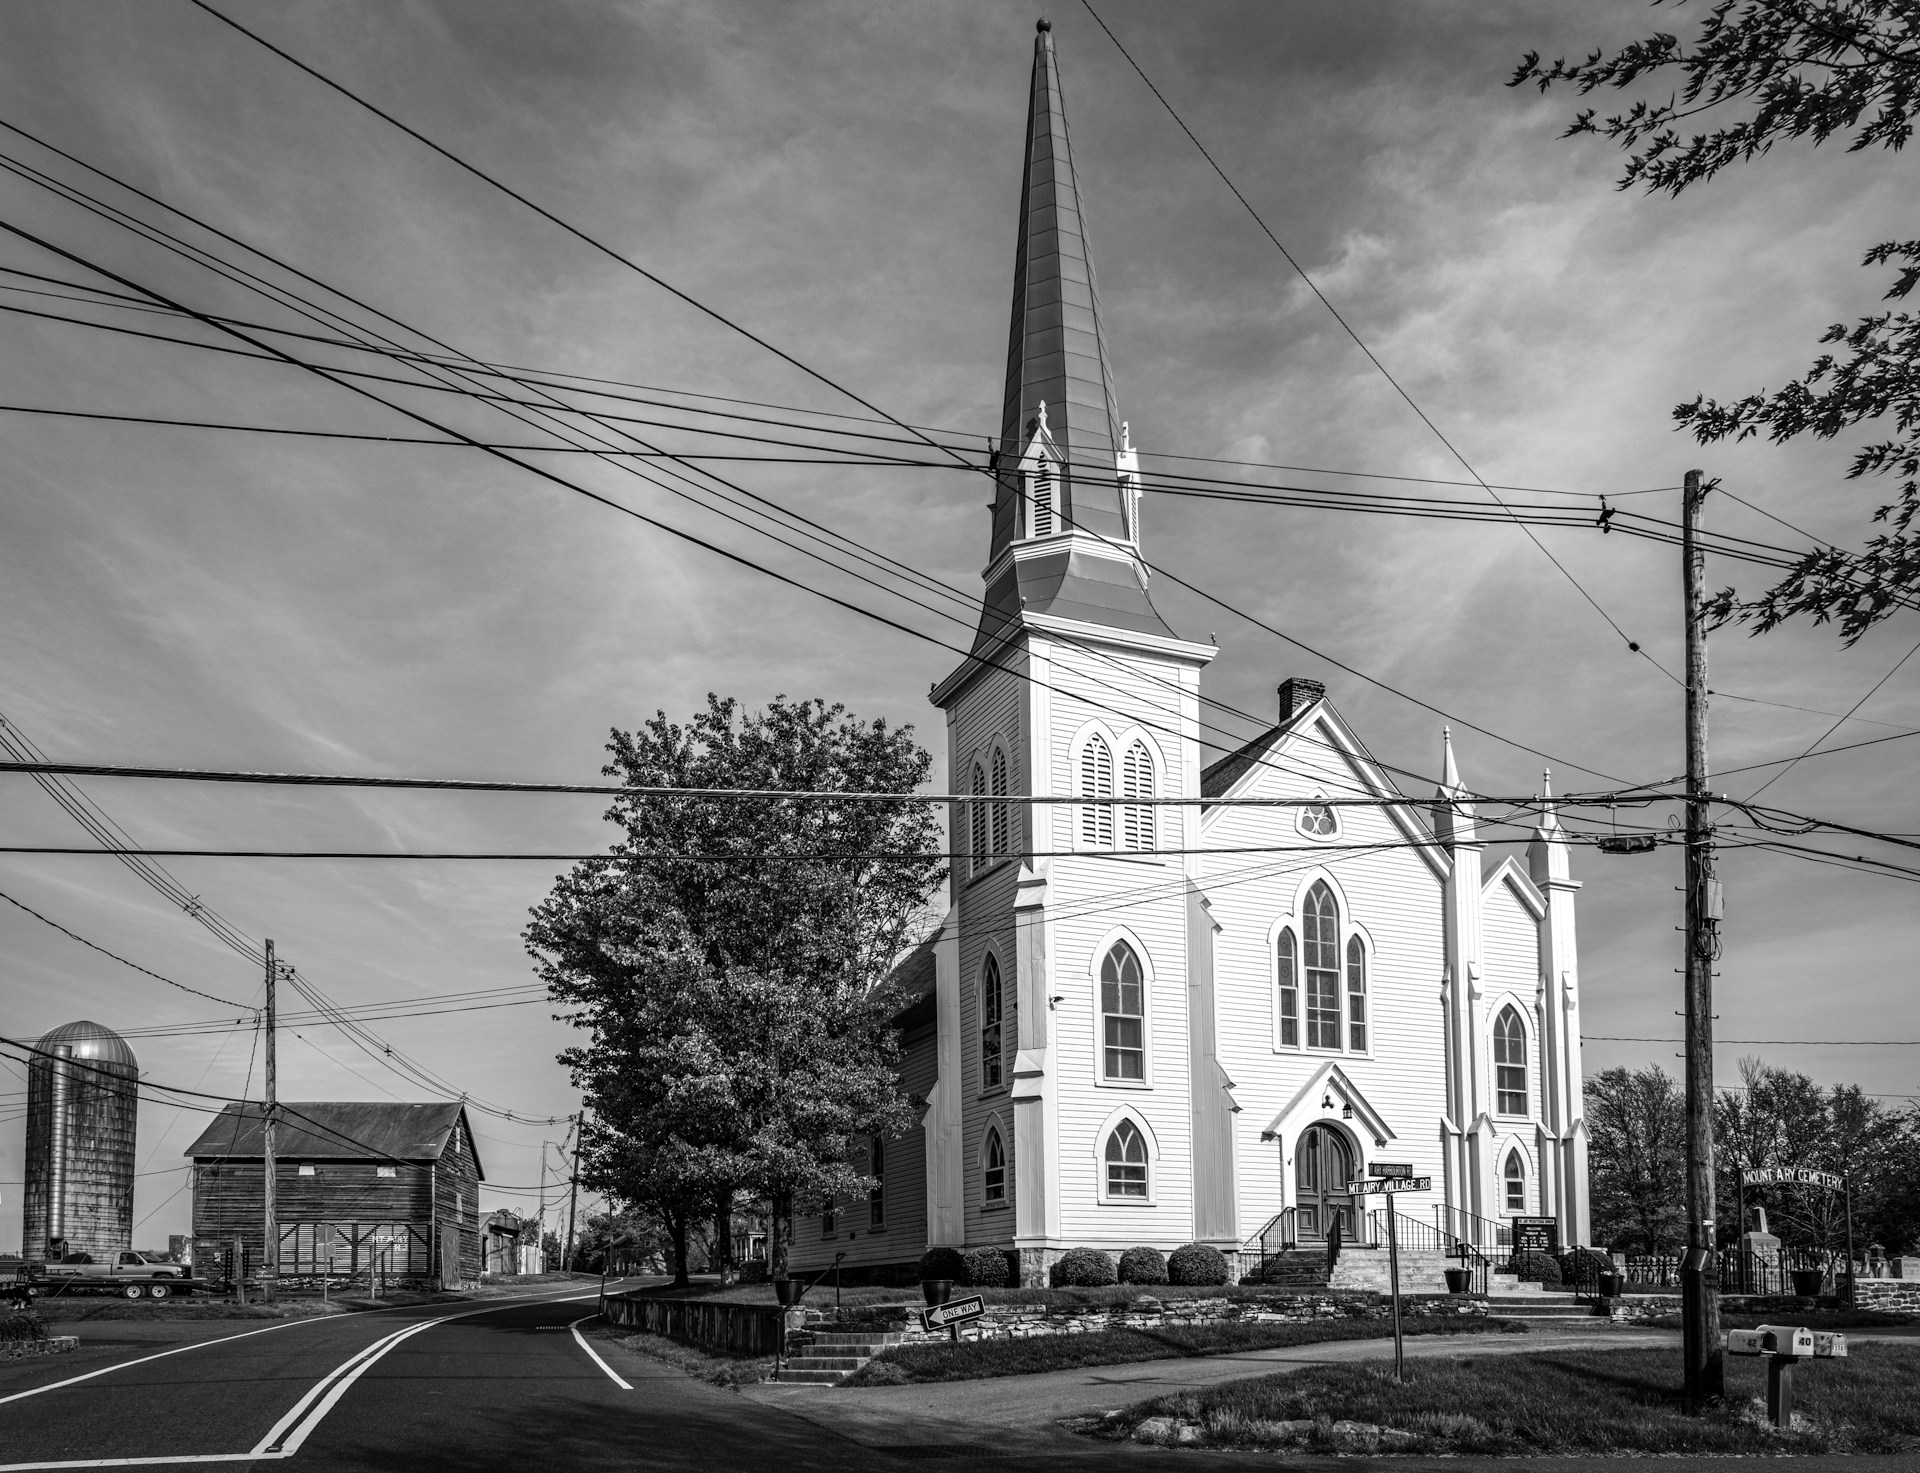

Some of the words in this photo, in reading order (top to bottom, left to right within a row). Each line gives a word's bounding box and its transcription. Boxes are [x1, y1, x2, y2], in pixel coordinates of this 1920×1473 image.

[1348, 1182, 1360, 1194] MT
[1362, 1181, 1380, 1193] AIRY
[1384, 1179, 1416, 1192] VILLAGE
[1419, 1178, 1431, 1190] RD
[1743, 1168, 1772, 1184] MOUNT
[1797, 1169, 1843, 1190] CEMETERY
[942, 1307, 959, 1319] ONE
[960, 1302, 977, 1314] WAY
[1747, 1338, 1757, 1348] 42
[1798, 1337, 1811, 1346] 40
